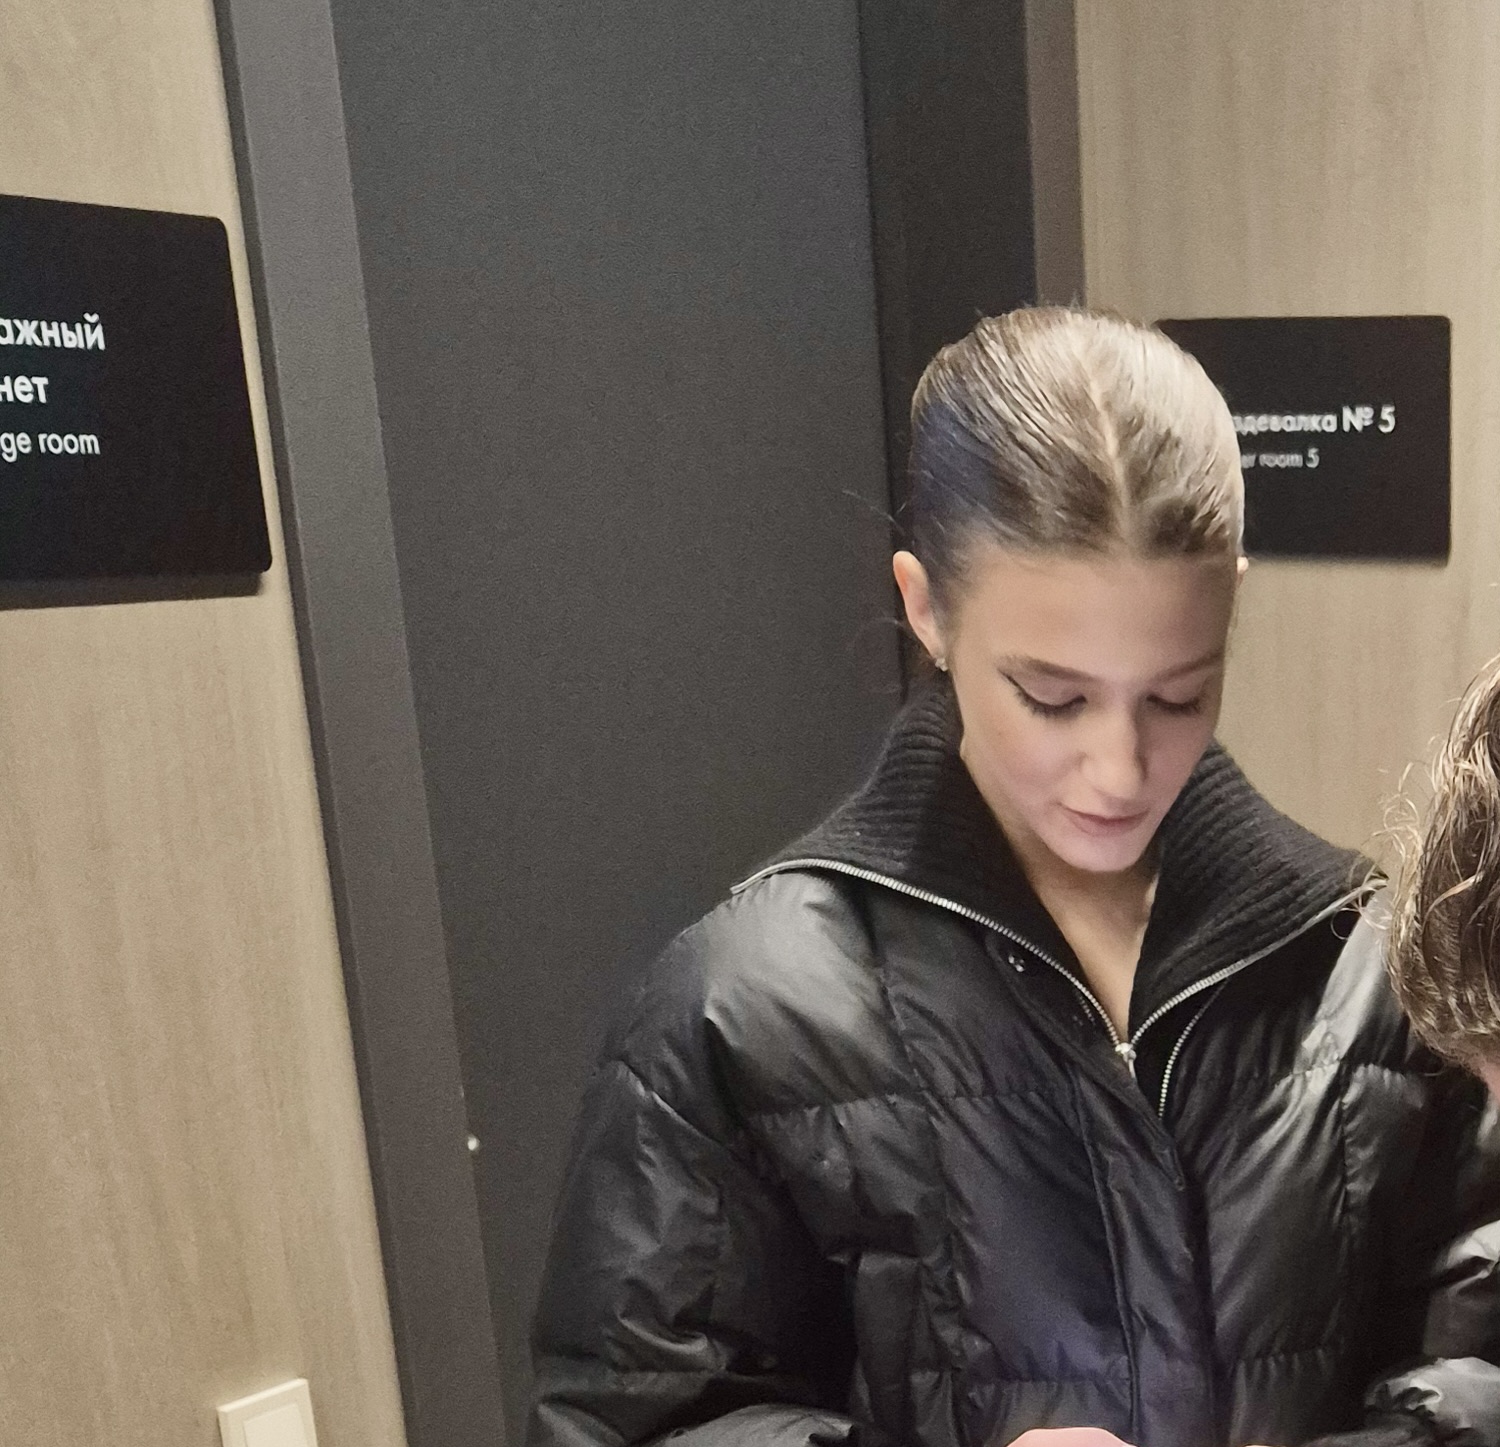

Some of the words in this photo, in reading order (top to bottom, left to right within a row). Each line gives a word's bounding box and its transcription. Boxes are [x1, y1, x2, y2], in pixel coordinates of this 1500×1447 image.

[1378, 404, 1396, 433] 5
[38, 433, 101, 455] room
[1259, 453, 1303, 469] room
[1305, 447, 1320, 469] 5
